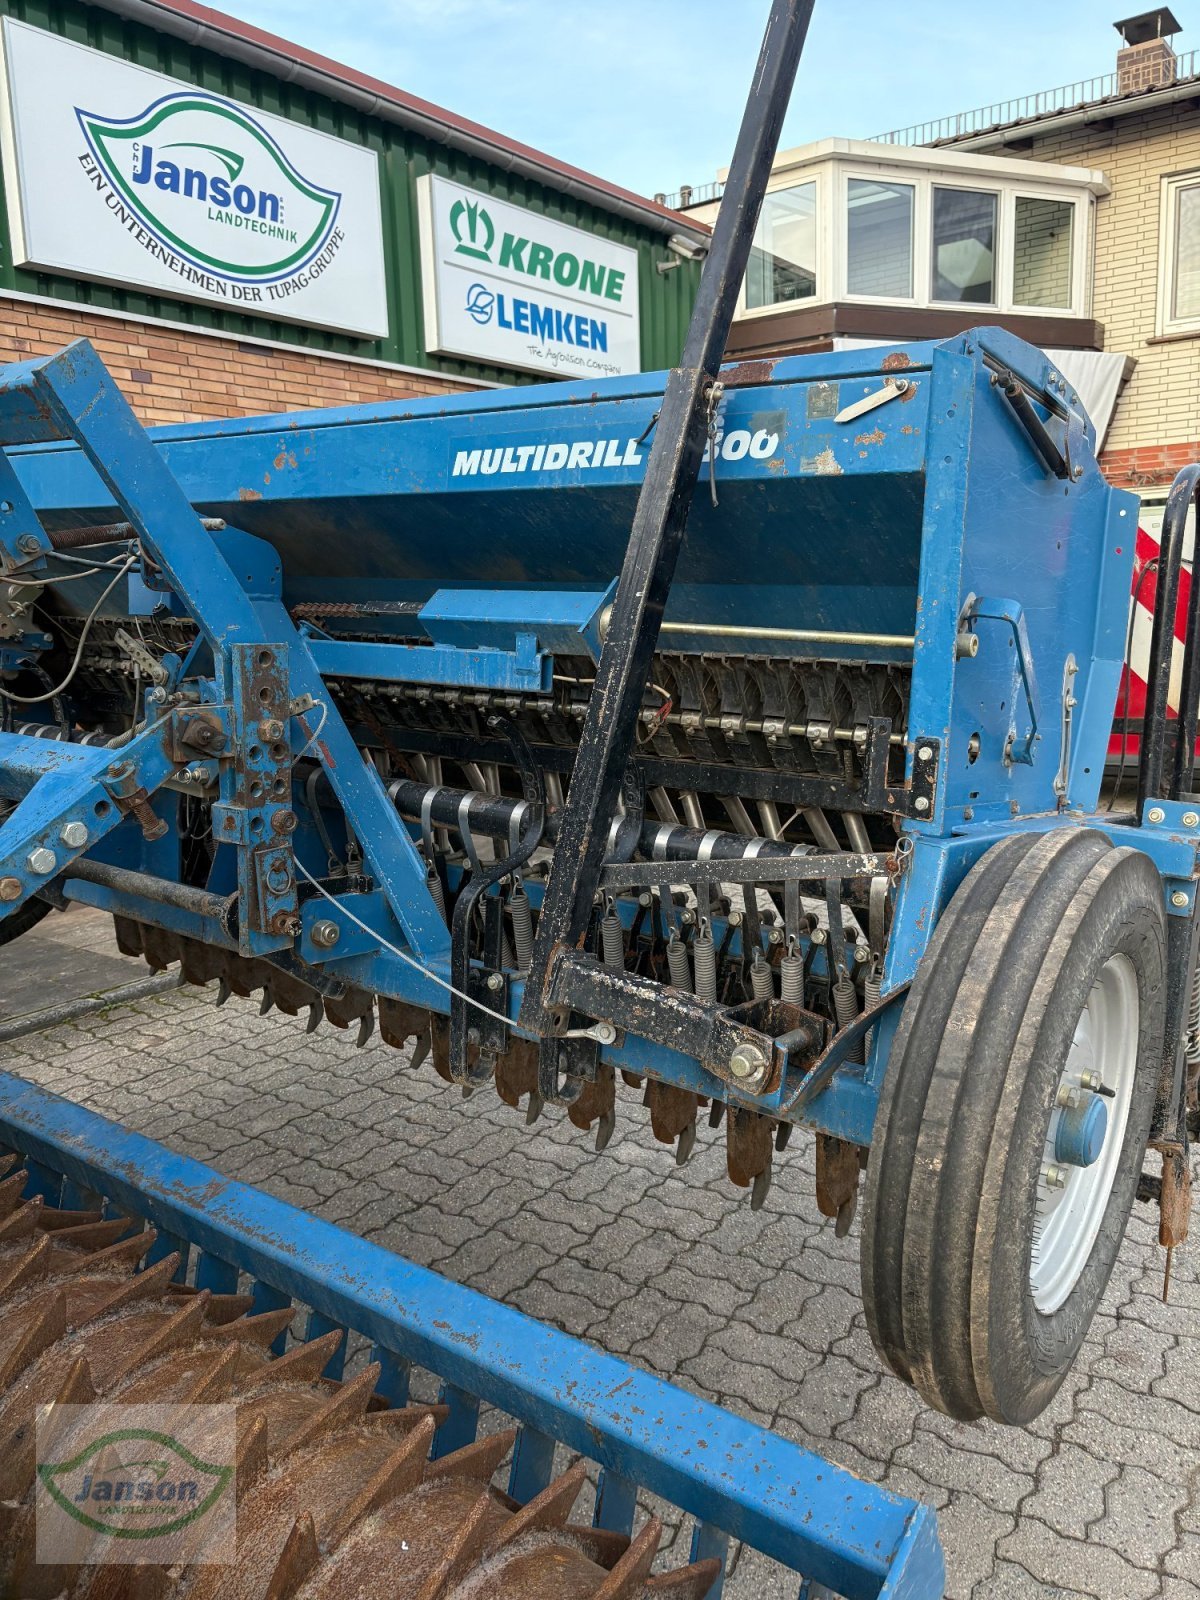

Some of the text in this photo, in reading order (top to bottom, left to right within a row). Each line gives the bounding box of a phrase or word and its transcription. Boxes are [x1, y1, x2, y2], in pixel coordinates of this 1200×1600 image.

[132, 144, 280, 223] Janson
[78, 152, 346, 302] EIN UNTERNEHMEN DER TUPAG-GRUPPE
[207, 207, 298, 244] LANDTECHNIK
[498, 232, 626, 303] KRONE
[496, 293, 608, 353] LEMKEN
[527, 345, 543, 358] The
[545, 348, 585, 367] Agrovision
[452, 438, 643, 477] MULTIDRILL
